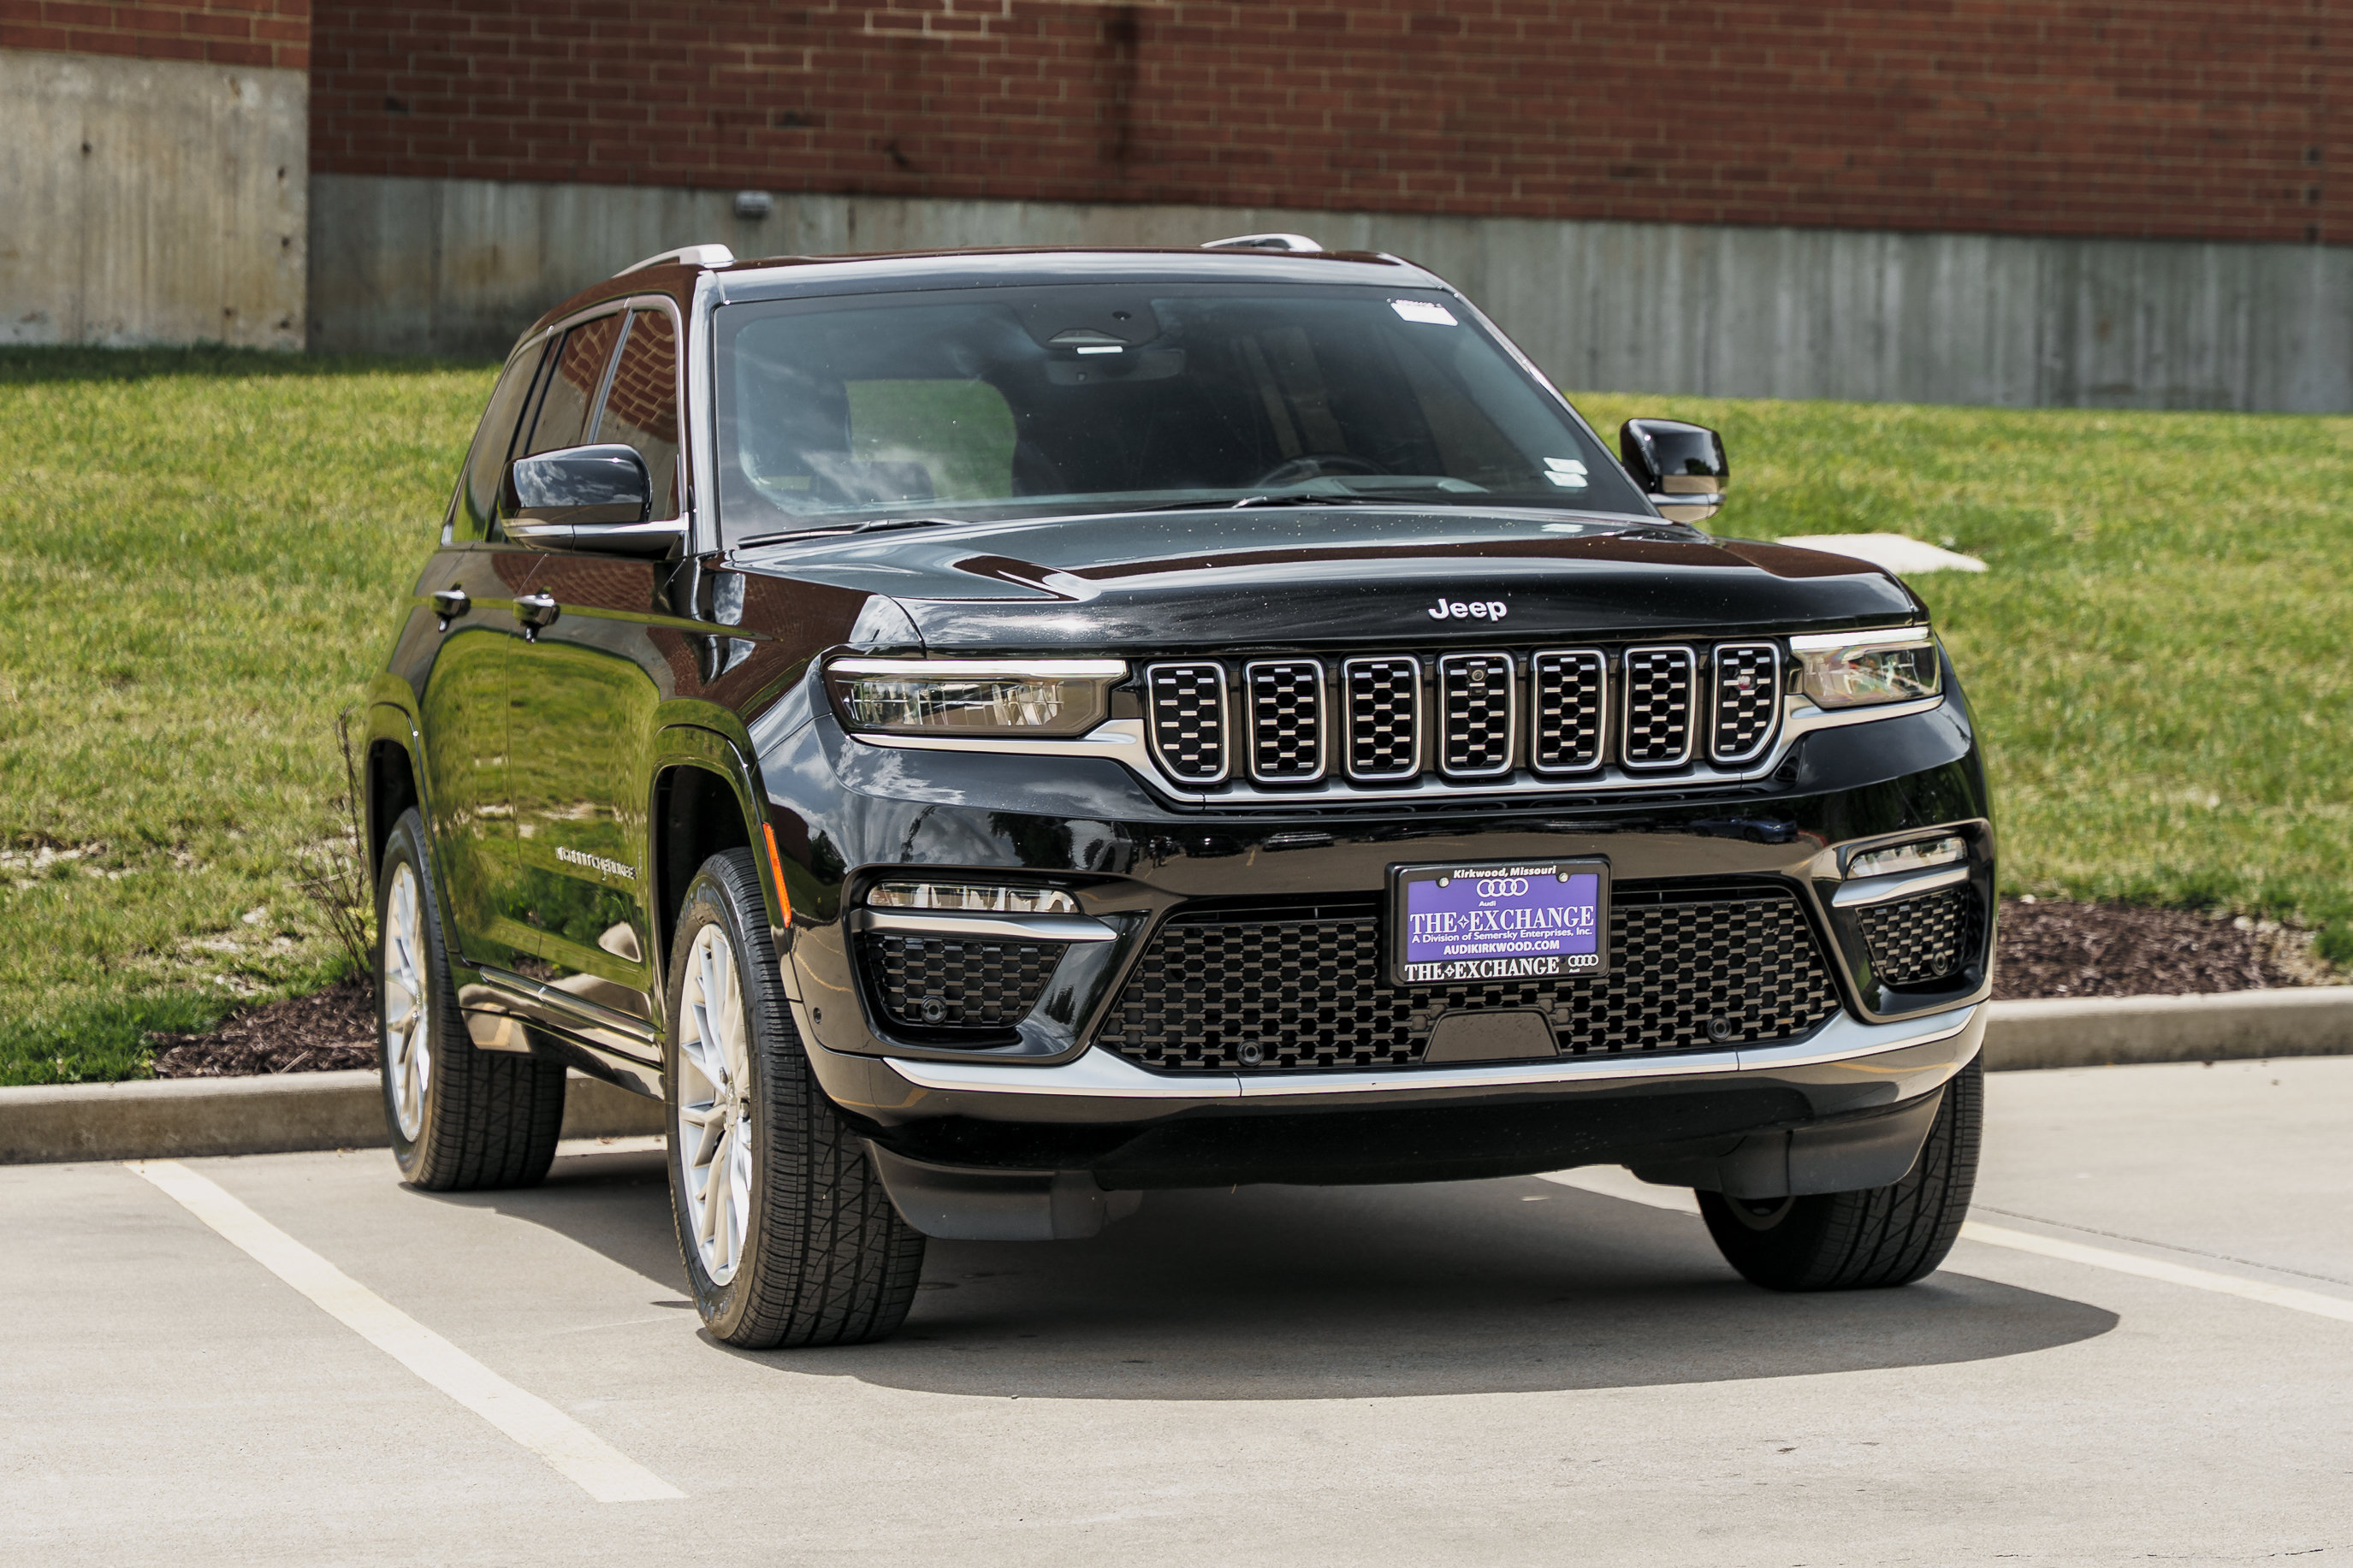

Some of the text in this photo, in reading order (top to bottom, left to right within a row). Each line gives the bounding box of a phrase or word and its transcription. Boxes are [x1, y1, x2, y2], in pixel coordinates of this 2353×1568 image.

[1427, 598, 1507, 622] Jeep
[1453, 865, 1557, 879] Kirkwood, Missouri
[1410, 905, 1595, 935] THE EXCHANGE
[1411, 926, 1592, 944] A Division of Semersky Enterprises, Inc.
[1443, 940, 1560, 956] AUDIKIRKWOOD.COM
[1404, 956, 1560, 982] THE EXCHANGE
